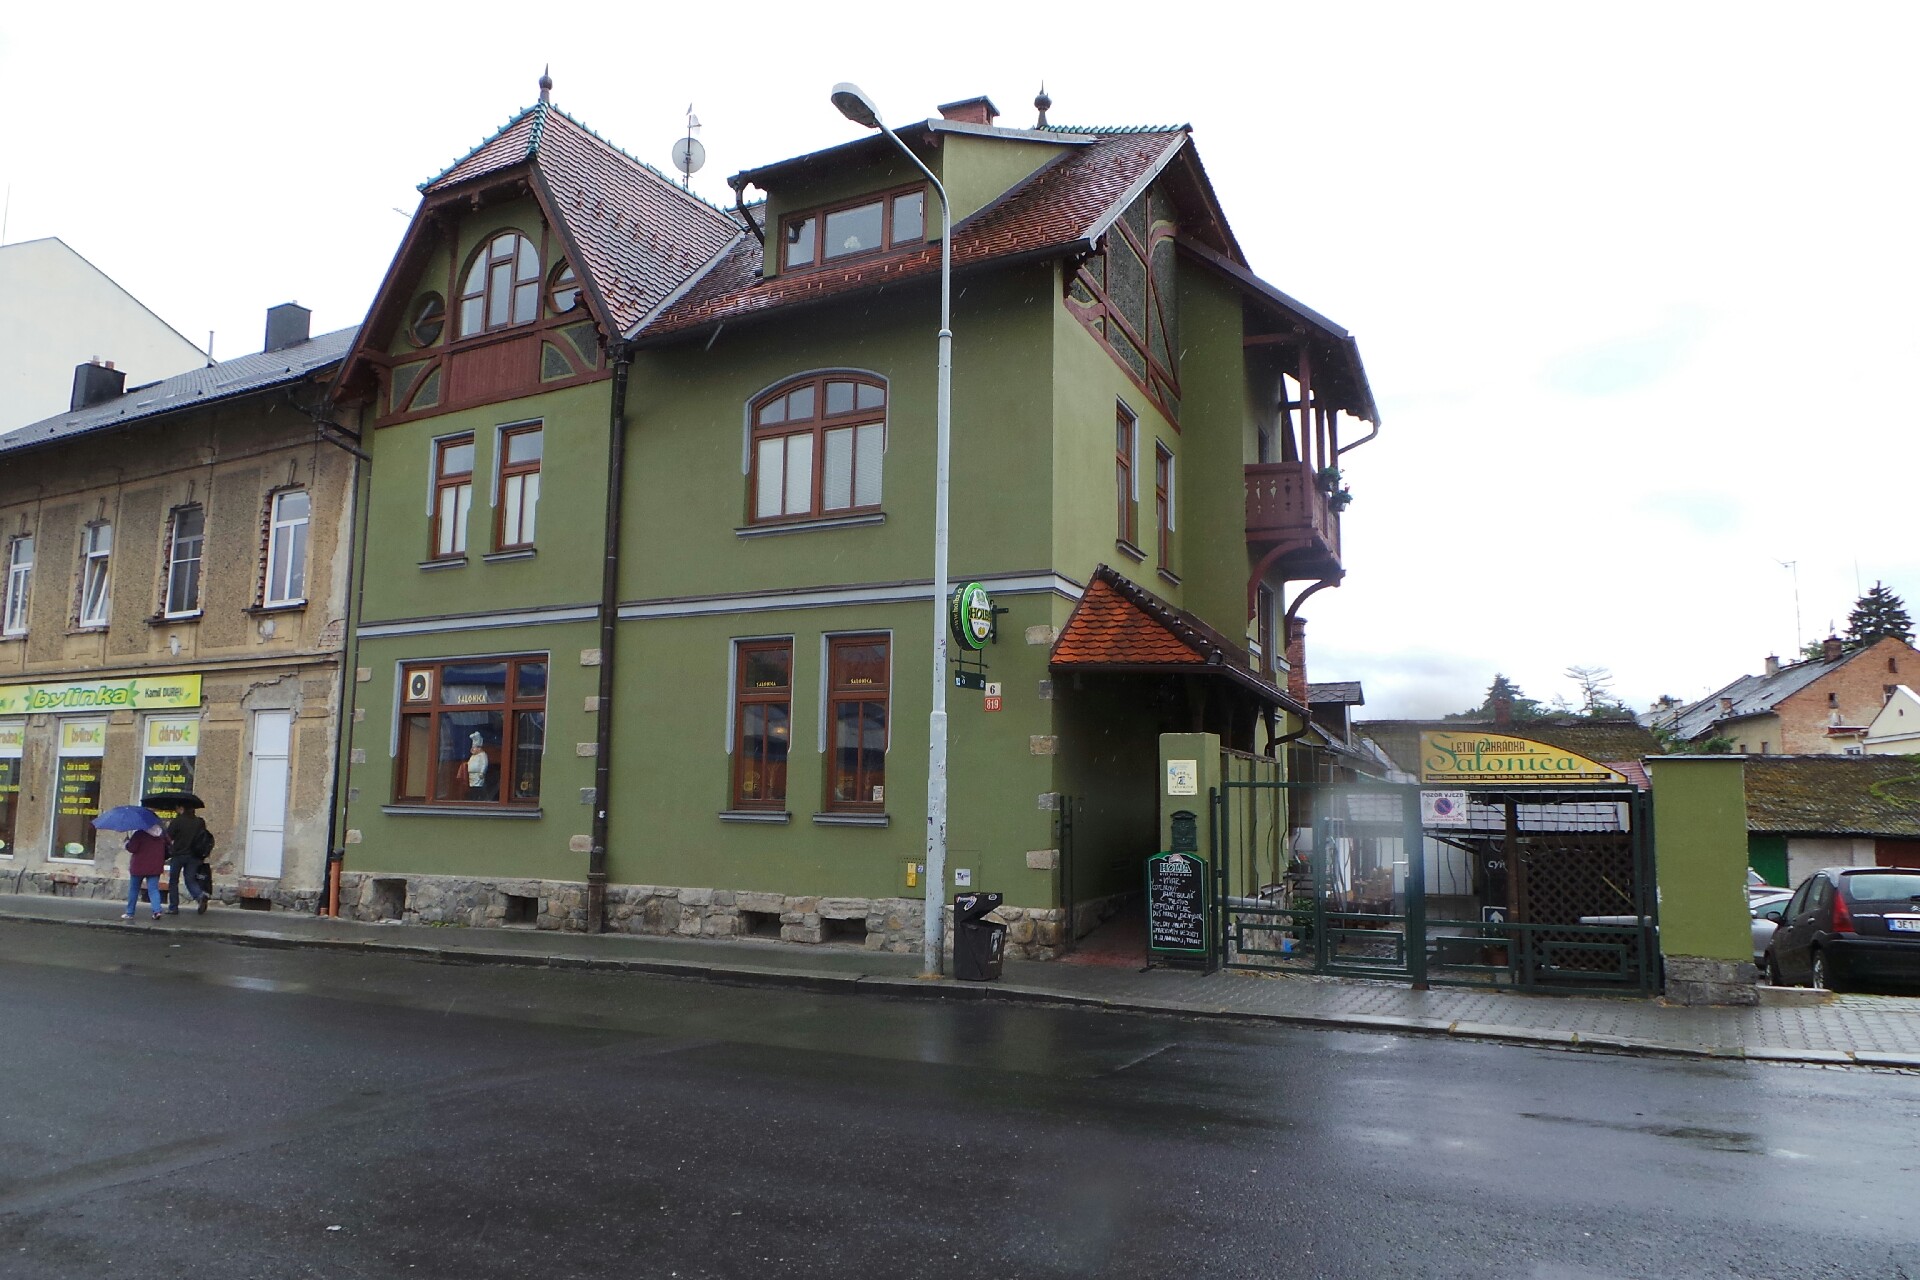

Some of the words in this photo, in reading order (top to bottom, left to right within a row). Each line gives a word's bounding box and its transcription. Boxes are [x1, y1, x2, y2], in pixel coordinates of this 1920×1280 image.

[990, 684, 996, 694] 6
[33, 685, 129, 709] bylinka
[986, 699, 999, 710] 819
[1451, 739, 1475, 752] LETNÍ
[1480, 740, 1525, 752] ZAHRÁDKA
[1425, 733, 1582, 772] Salonica
